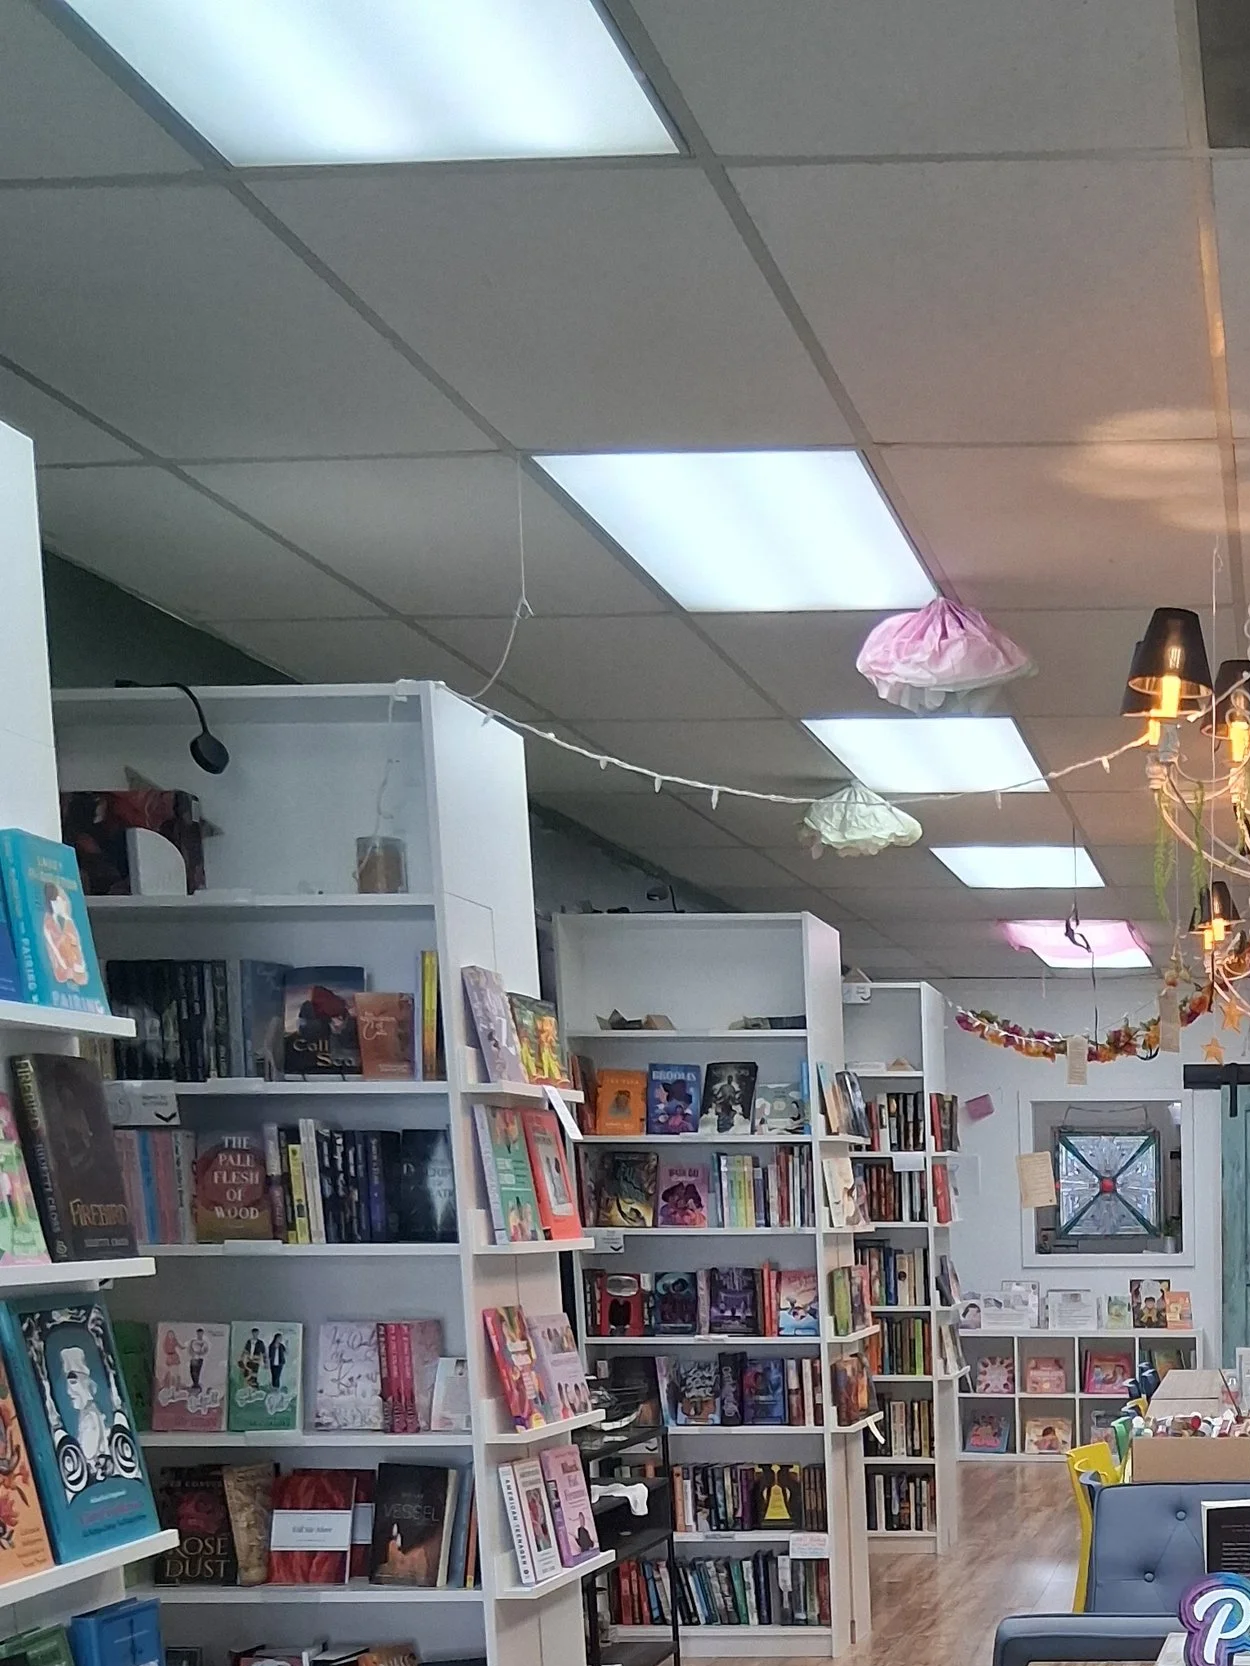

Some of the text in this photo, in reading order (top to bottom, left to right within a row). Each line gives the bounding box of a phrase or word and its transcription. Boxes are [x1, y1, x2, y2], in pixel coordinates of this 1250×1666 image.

[222, 1136, 250, 1149] THE
[218, 1153, 255, 1167] PALE
[213, 1171, 260, 1184] FLESH
[226, 1189, 244, 1201] OF
[69, 1199, 129, 1227] FIREBIRD
[214, 1206, 260, 1219] WOOD
[384, 1503, 440, 1522] VESSEL
[166, 1559, 231, 1578] DUST
